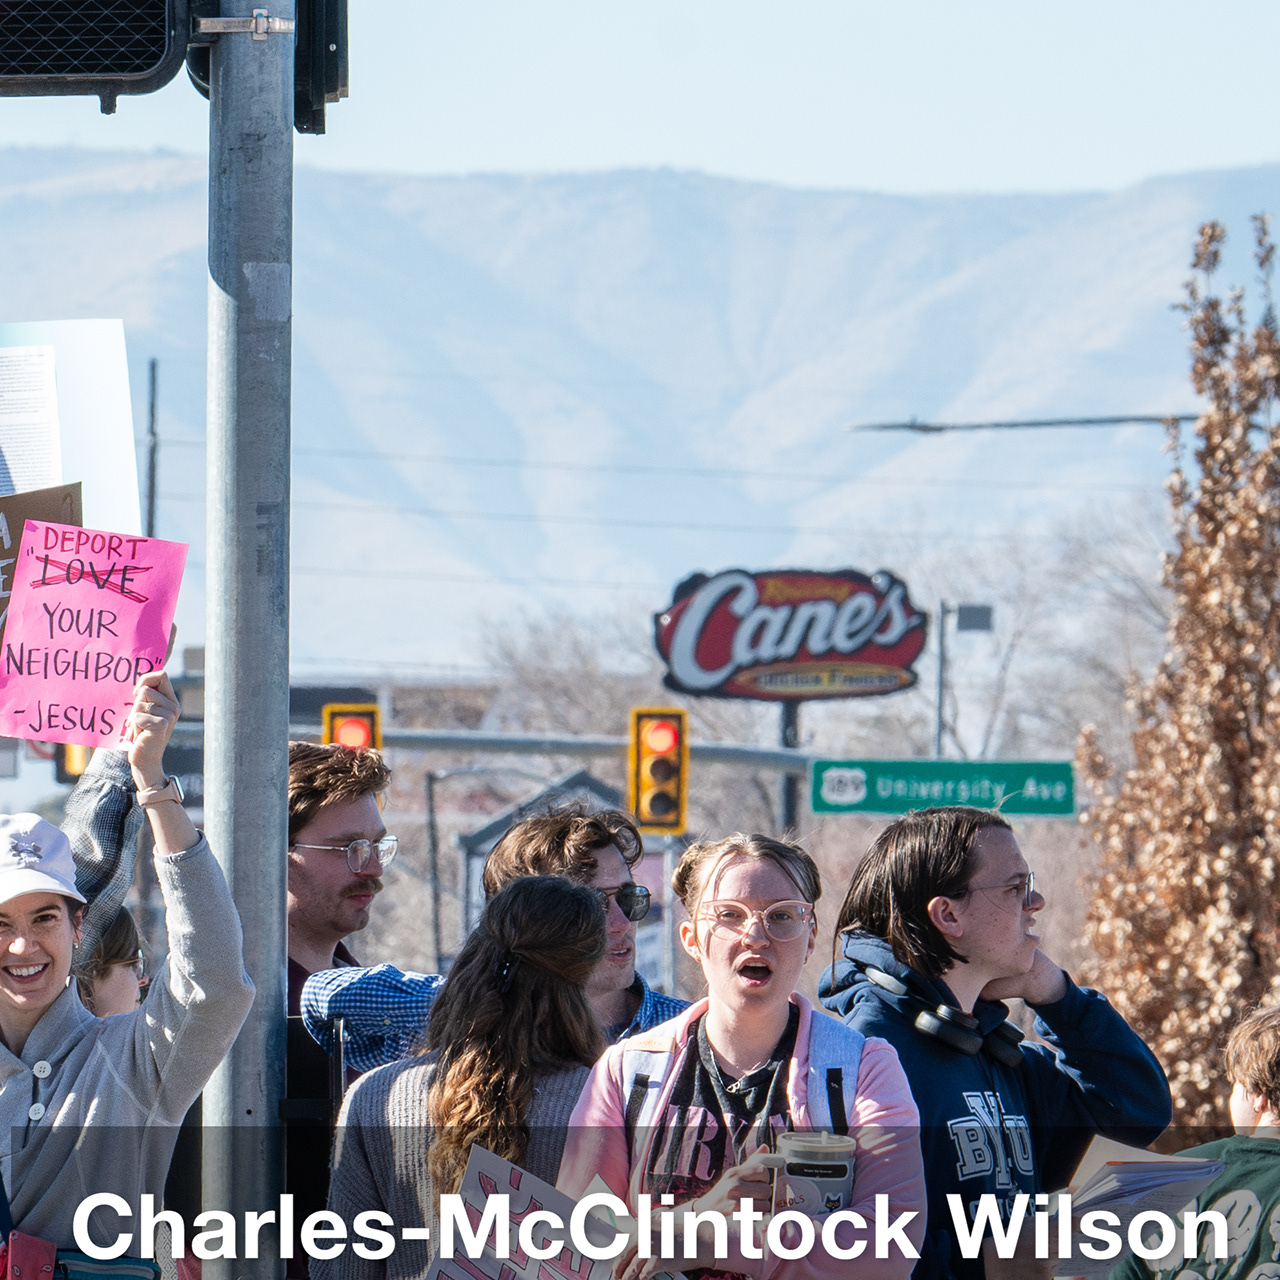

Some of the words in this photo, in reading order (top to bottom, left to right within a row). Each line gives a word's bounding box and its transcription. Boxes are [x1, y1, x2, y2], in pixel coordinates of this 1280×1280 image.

[44, 526, 148, 560] DEPORT
[43, 602, 119, 639] YOUR
[669, 570, 922, 690] Cane's
[947, 1091, 1034, 1189] BYU
